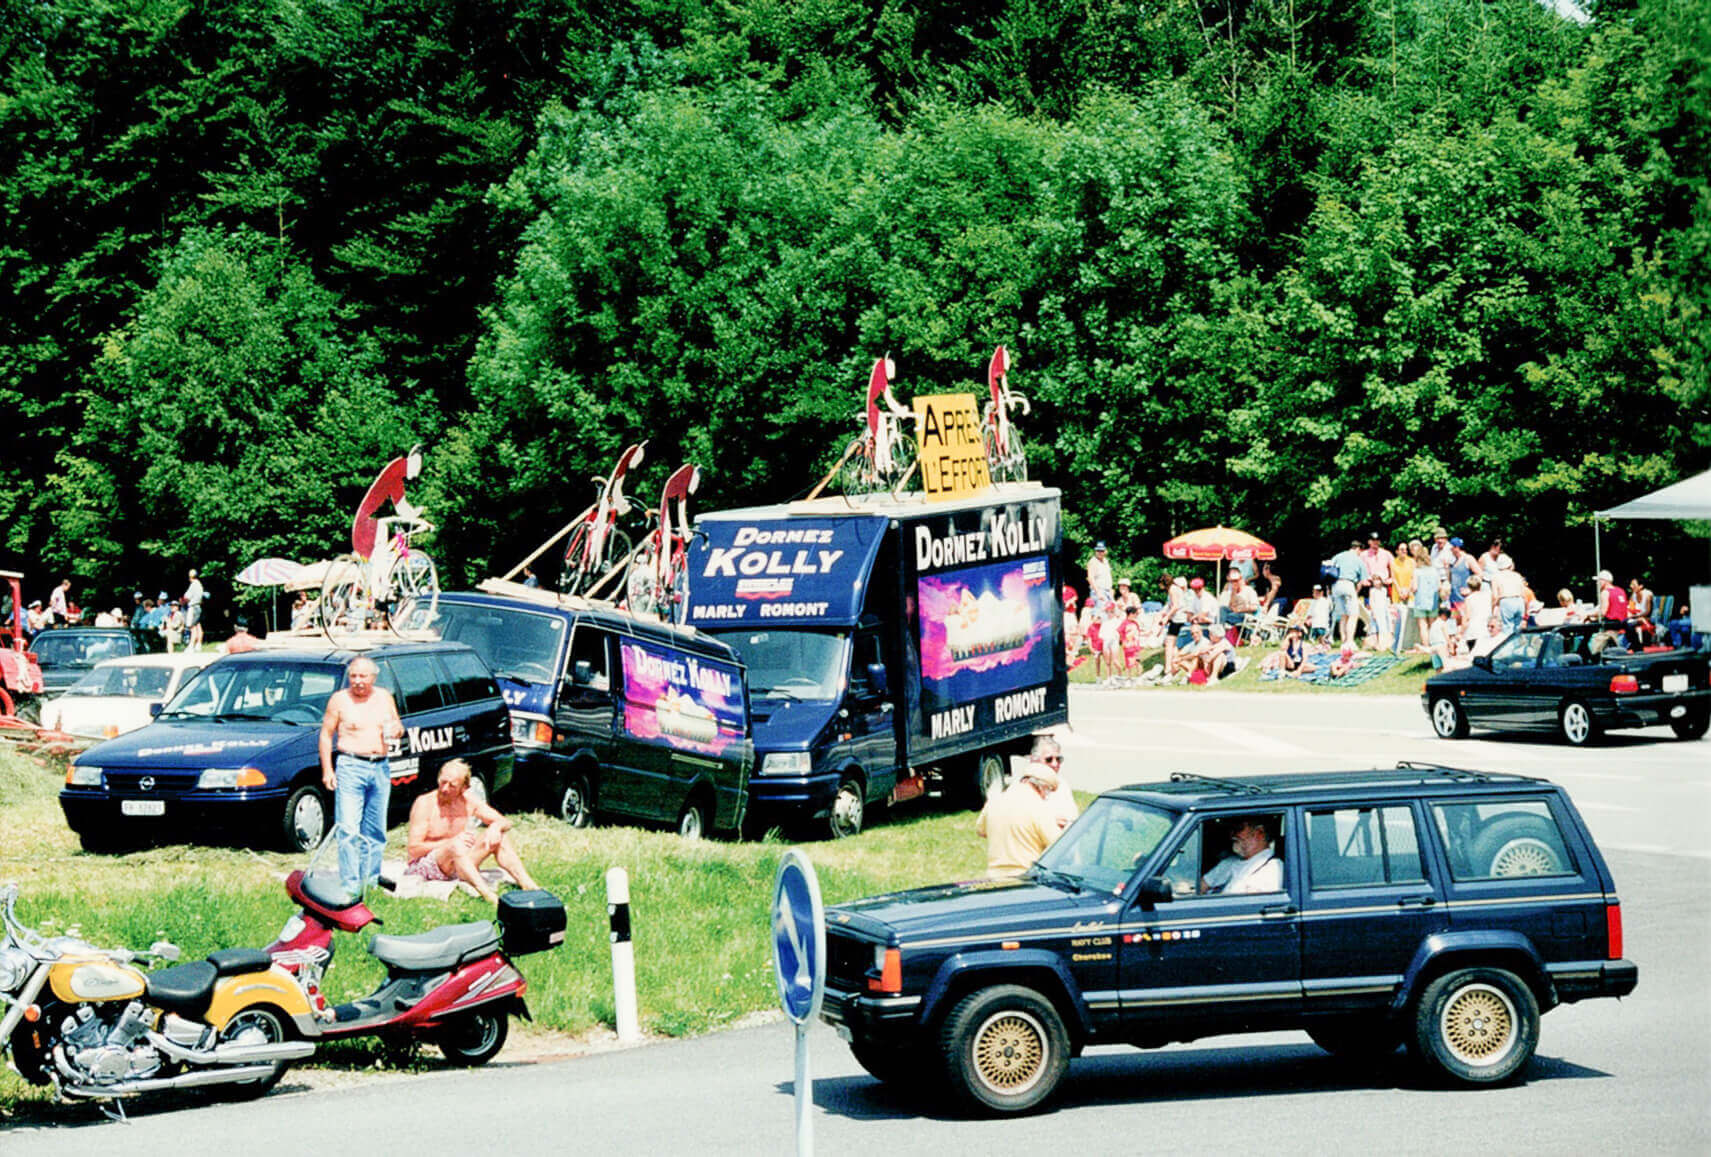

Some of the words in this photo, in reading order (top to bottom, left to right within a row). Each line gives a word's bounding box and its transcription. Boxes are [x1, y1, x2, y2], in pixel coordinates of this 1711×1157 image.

[733, 527, 834, 546] DORMEZ
[914, 524, 987, 571] DORMEZ
[991, 513, 1047, 558] KOLLY
[703, 548, 843, 577] KOLLY
[693, 604, 747, 619] MARLY
[759, 602, 829, 617] ROMONT
[931, 704, 975, 740] MARLY
[995, 687, 1047, 723] ROMONT
[407, 726, 453, 754] KOLLY
